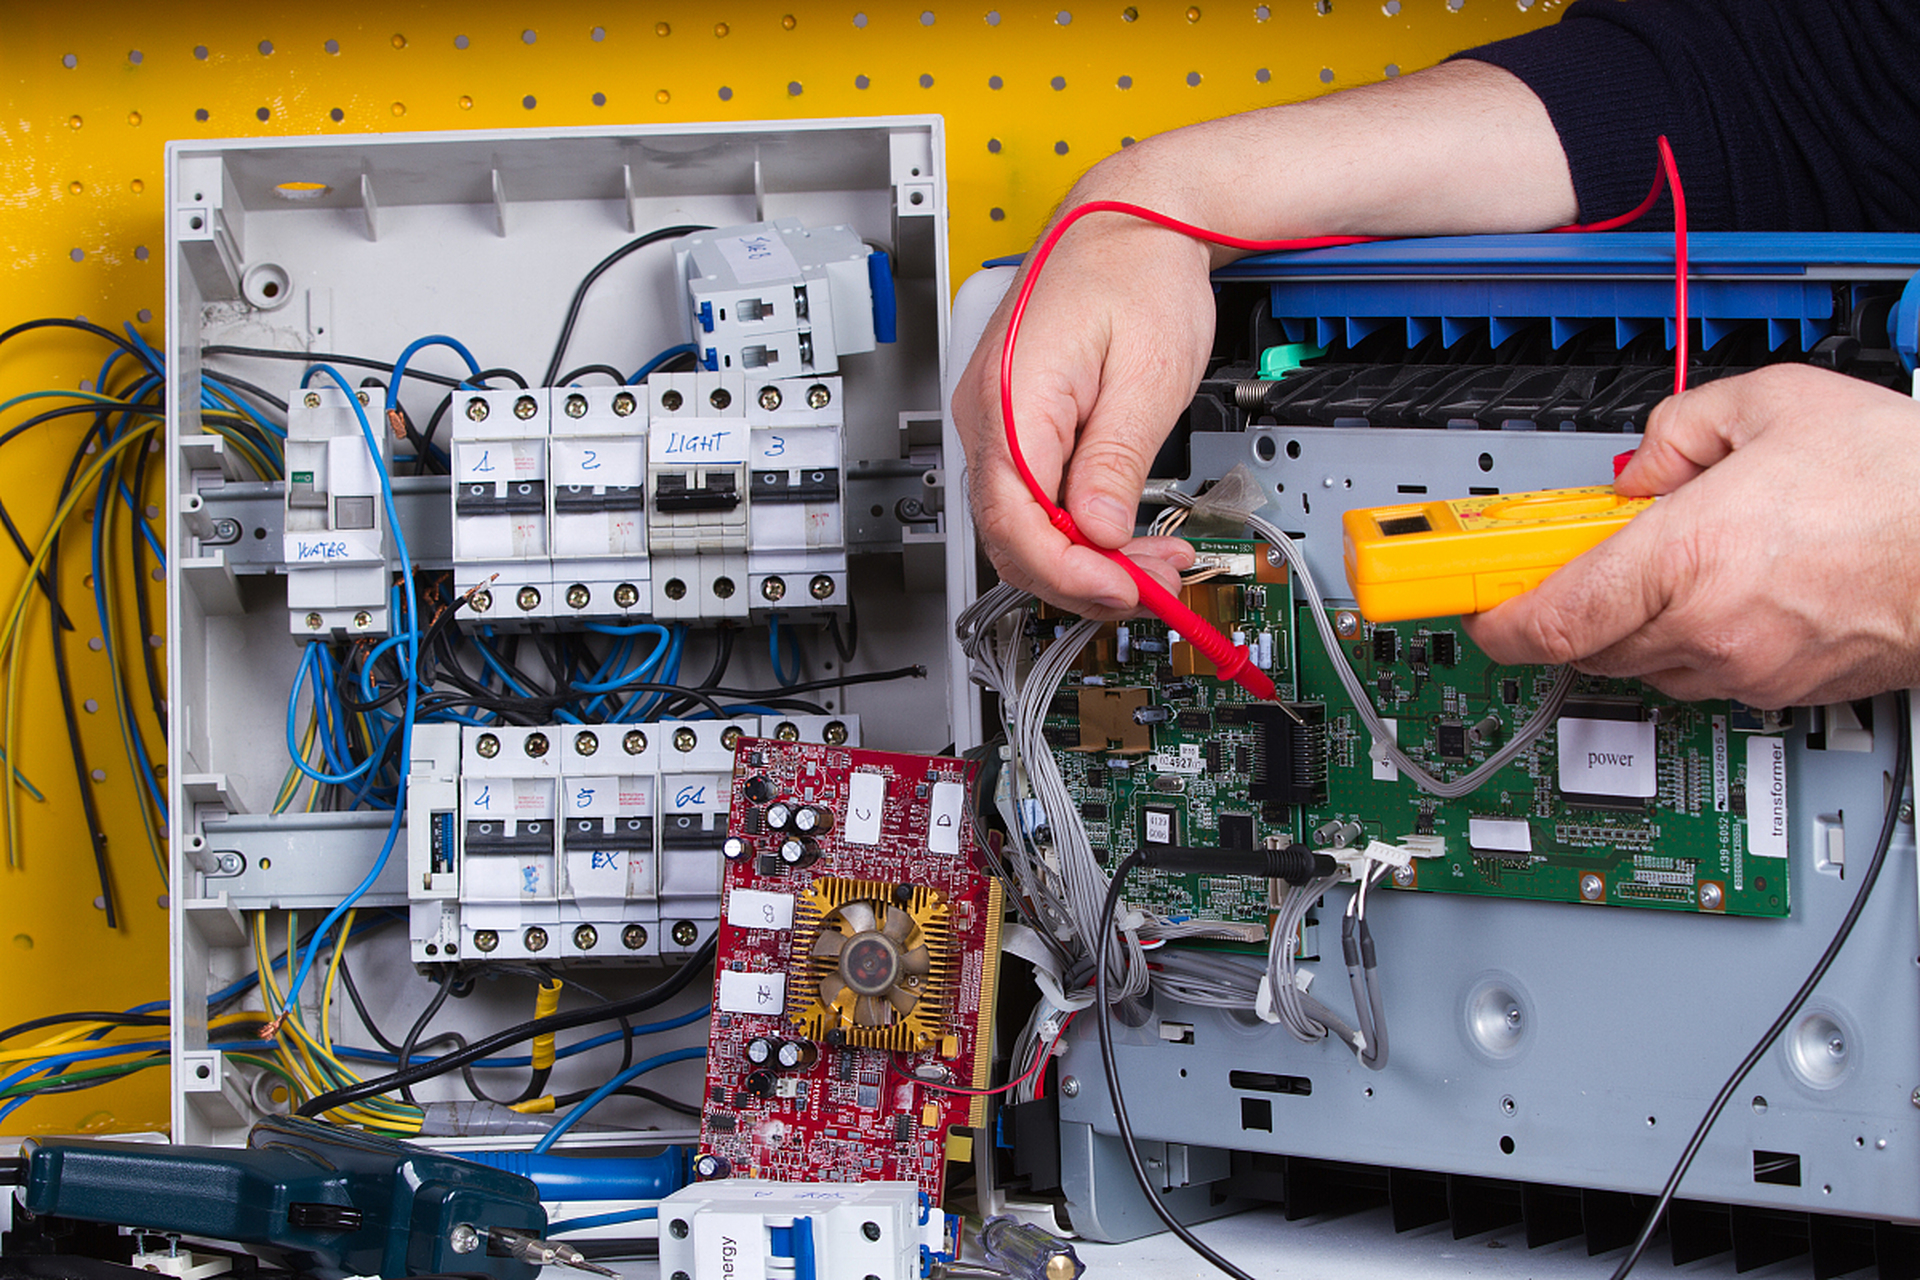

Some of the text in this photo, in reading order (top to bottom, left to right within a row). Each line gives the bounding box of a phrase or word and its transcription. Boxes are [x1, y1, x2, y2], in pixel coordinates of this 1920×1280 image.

[665, 432, 731, 453] LIGHT
[764, 436, 785, 456] 3
[472, 451, 495, 471] 1
[581, 451, 601, 469] 2
[298, 541, 349, 560] WATER
[1588, 751, 1634, 769] power
[474, 786, 490, 810] 4
[577, 788, 595, 808] 5
[1770, 743, 1784, 837] transformer
[937, 814, 951, 827] D
[592, 851, 620, 870] EX
